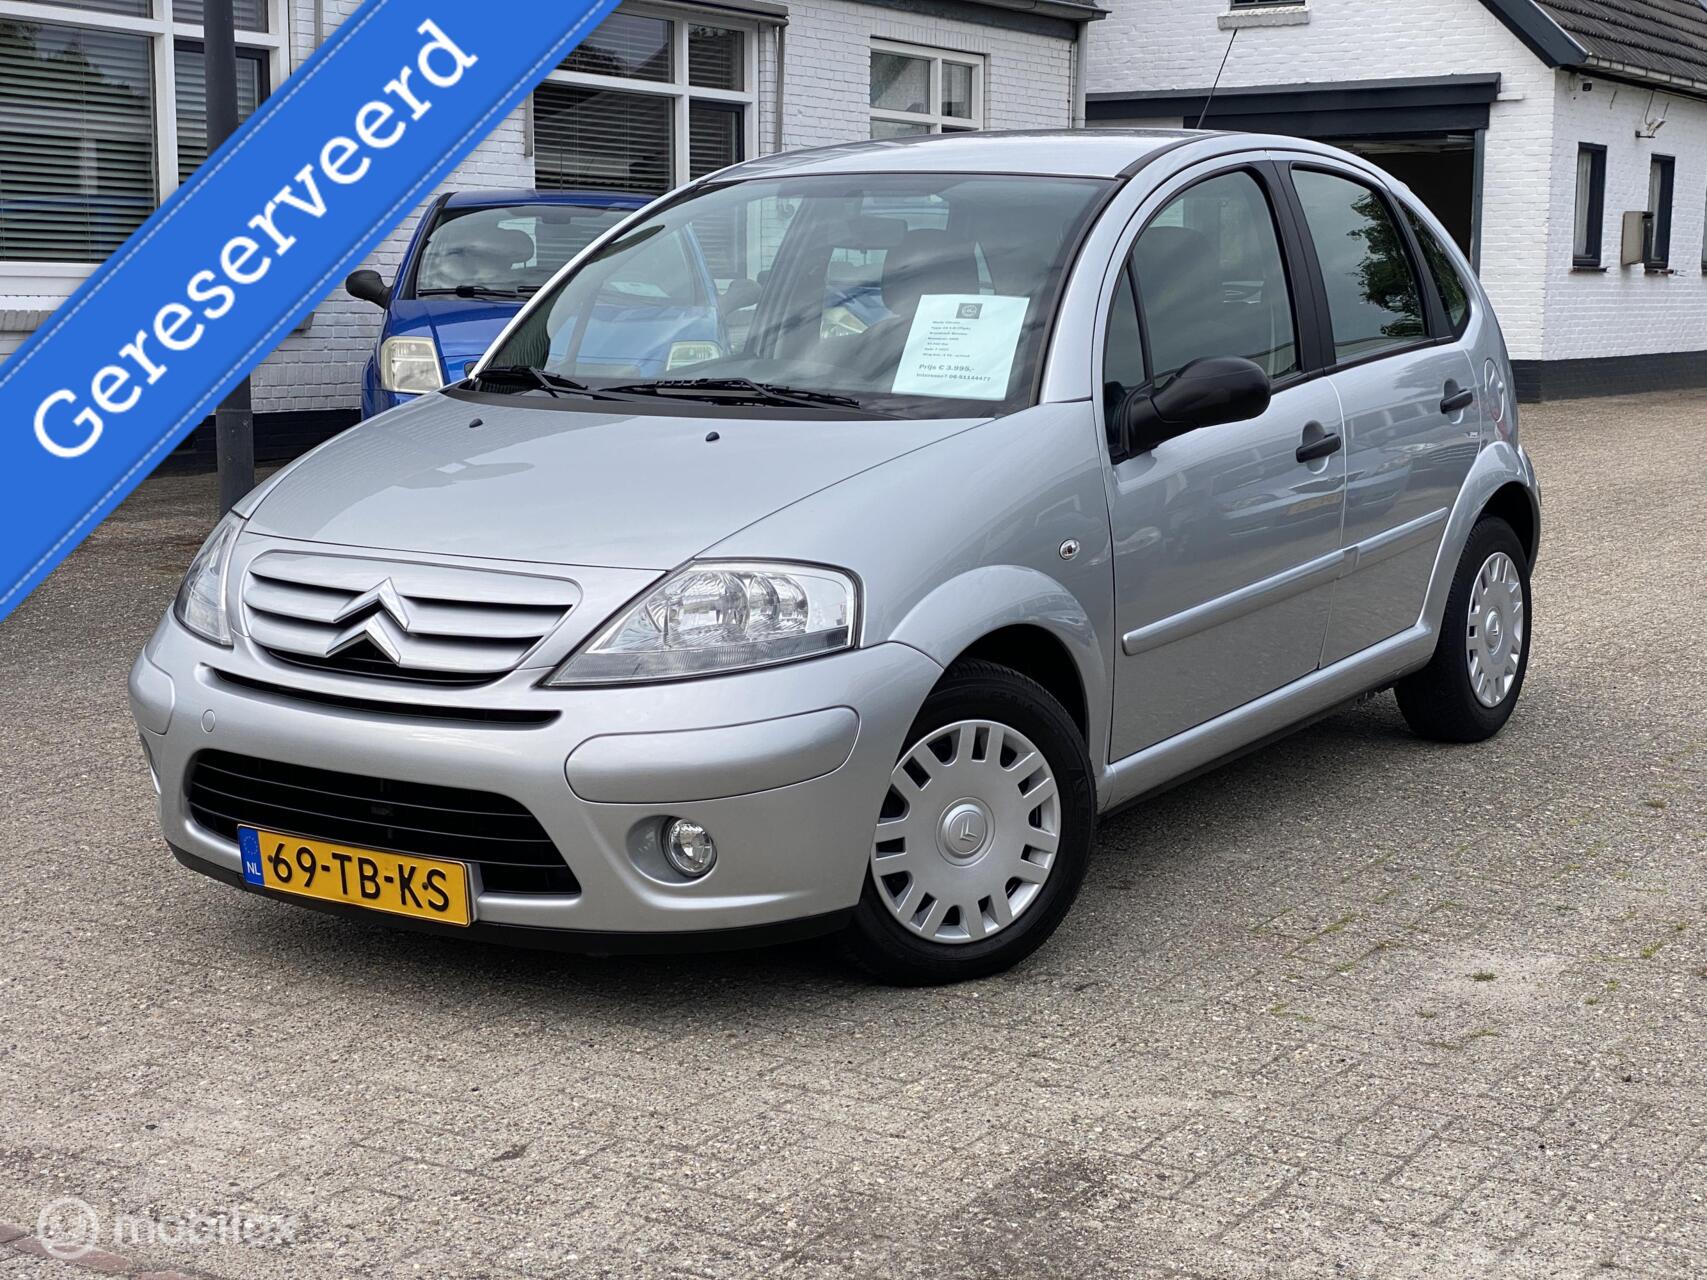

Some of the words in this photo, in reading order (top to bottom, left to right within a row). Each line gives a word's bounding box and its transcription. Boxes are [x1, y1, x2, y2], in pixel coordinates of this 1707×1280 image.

[918, 363, 937, 372] Prijs
[246, 861, 261, 876] NL
[271, 842, 450, 913] 69-TB-KS
